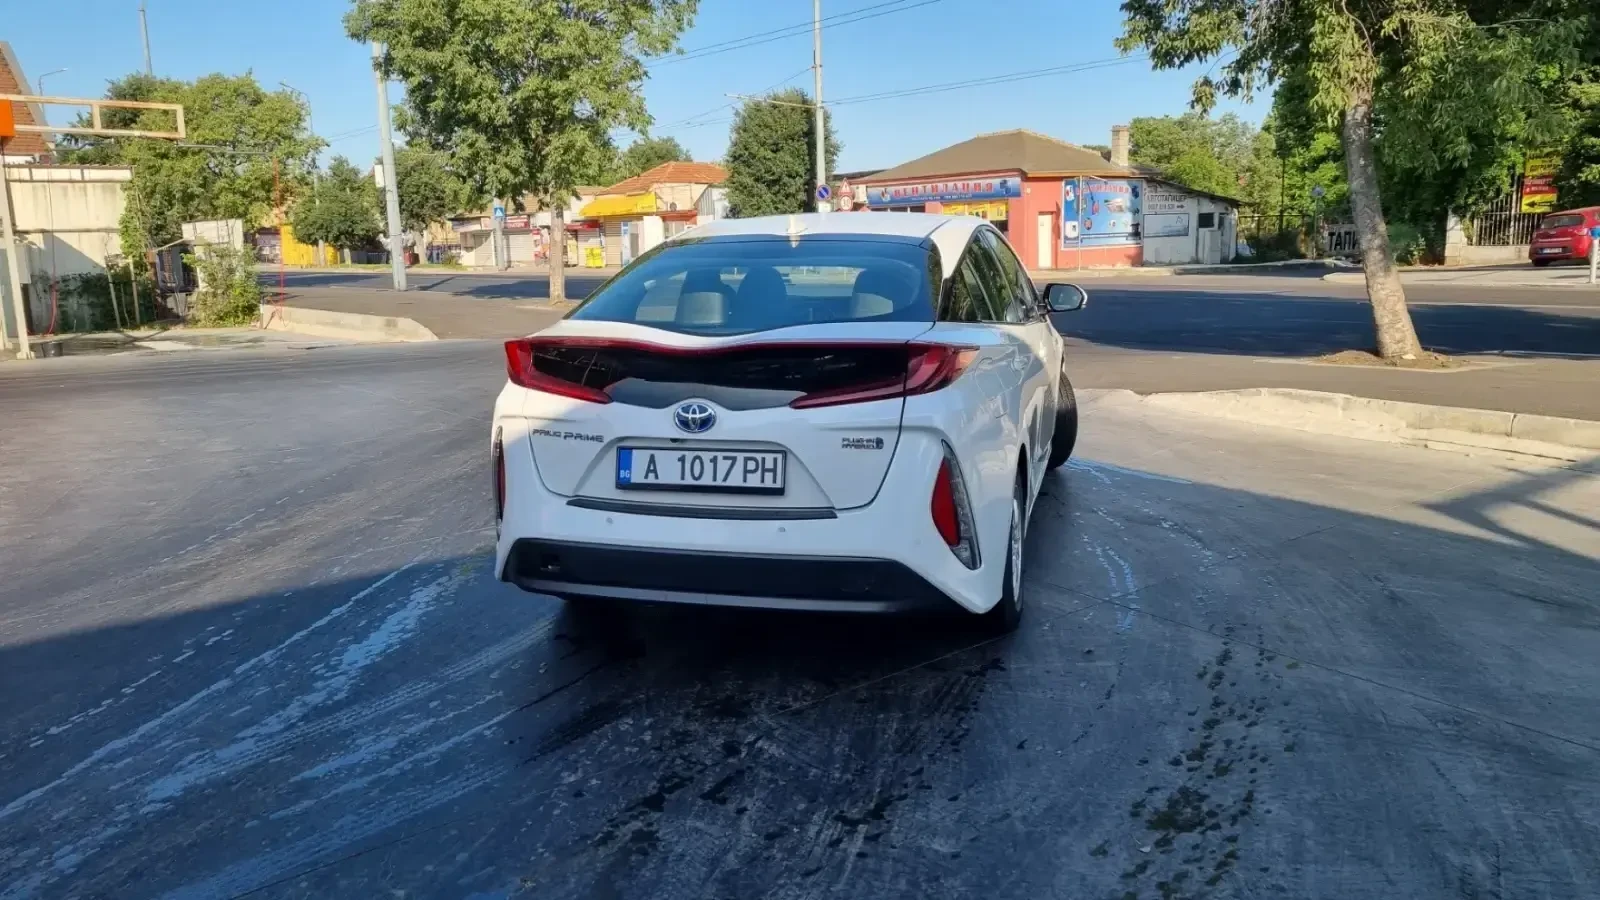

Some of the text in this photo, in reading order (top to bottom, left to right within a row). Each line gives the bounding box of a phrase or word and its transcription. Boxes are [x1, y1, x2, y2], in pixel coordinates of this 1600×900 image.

[893, 182, 993, 197] ВЕНТИЛАЦИЯ
[563, 431, 604, 443] PRIME
[620, 470, 630, 478] BG
[644, 453, 778, 484] A 1017 PH
